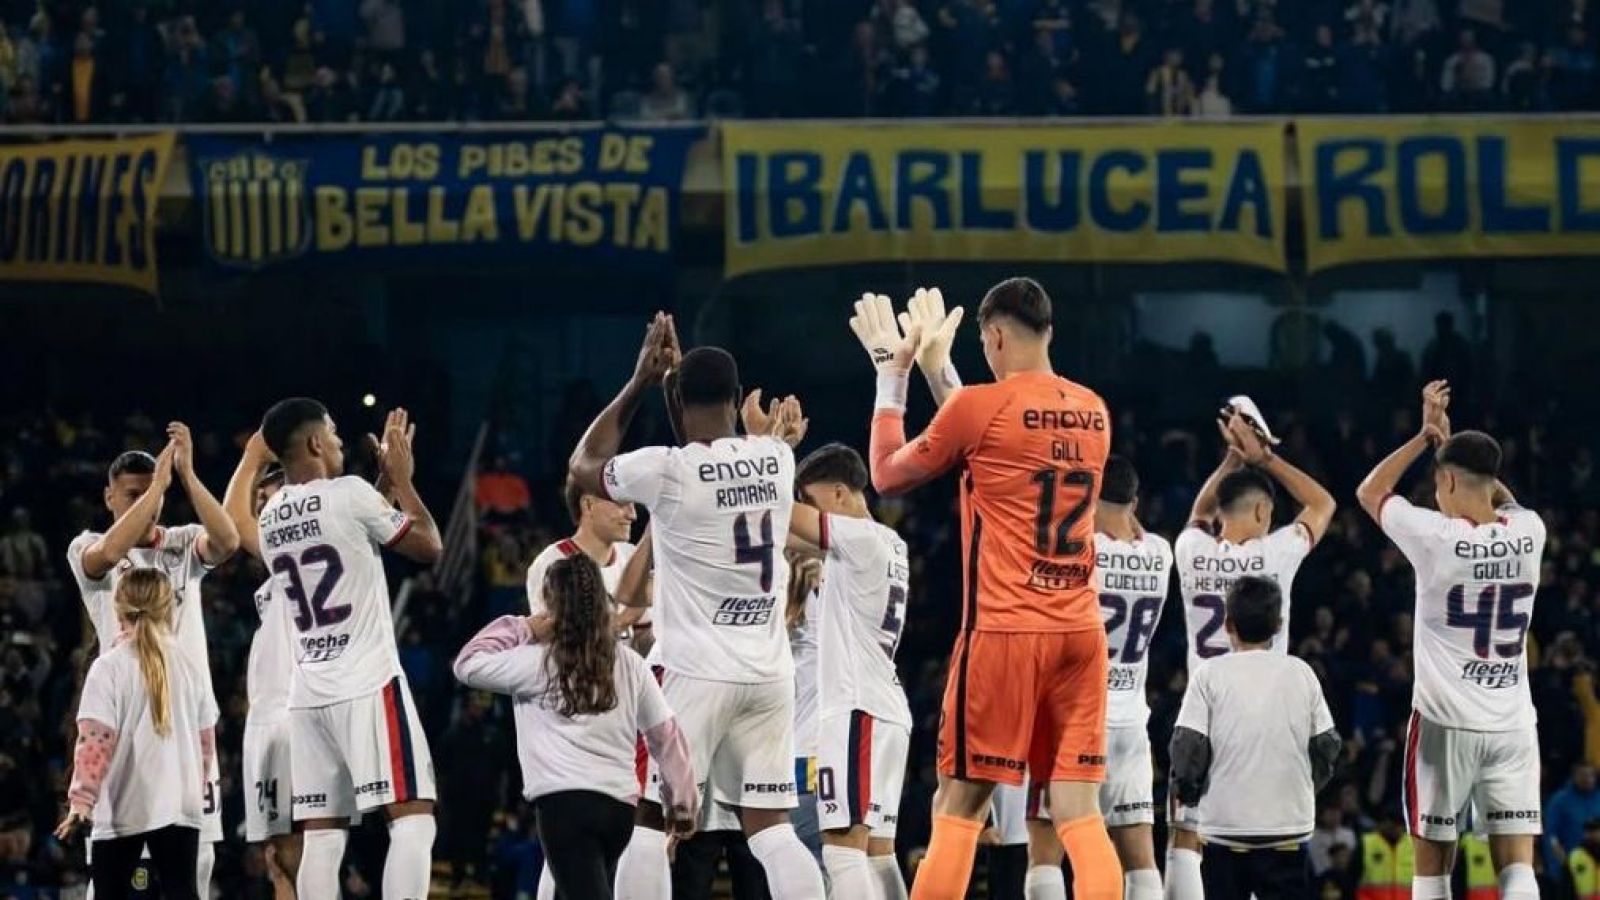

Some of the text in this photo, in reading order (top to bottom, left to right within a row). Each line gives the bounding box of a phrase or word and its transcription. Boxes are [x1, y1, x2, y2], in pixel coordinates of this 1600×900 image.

[362, 133, 654, 181] LOS PIBES DE
[736, 147, 1273, 242] IBARLUCEA
[315, 181, 671, 252] BELLA VISTA
[1022, 408, 1105, 431] enova
[1052, 440, 1084, 462] GILL
[699, 455, 779, 482] enova
[716, 480, 778, 509] ROMAÑA
[1032, 468, 1095, 556] 12
[733, 510, 775, 593] 4
[1096, 551, 1164, 572] enova
[1455, 537, 1534, 559] enova
[1193, 554, 1265, 573] enova
[1474, 560, 1521, 580] GULLI
[273, 543, 353, 632] 32
[1104, 573, 1158, 592] CUELLO
[719, 596, 777, 610] flecha
[714, 610, 771, 625] BUS
[1098, 593, 1163, 664] 28
[1446, 582, 1534, 660] 45
